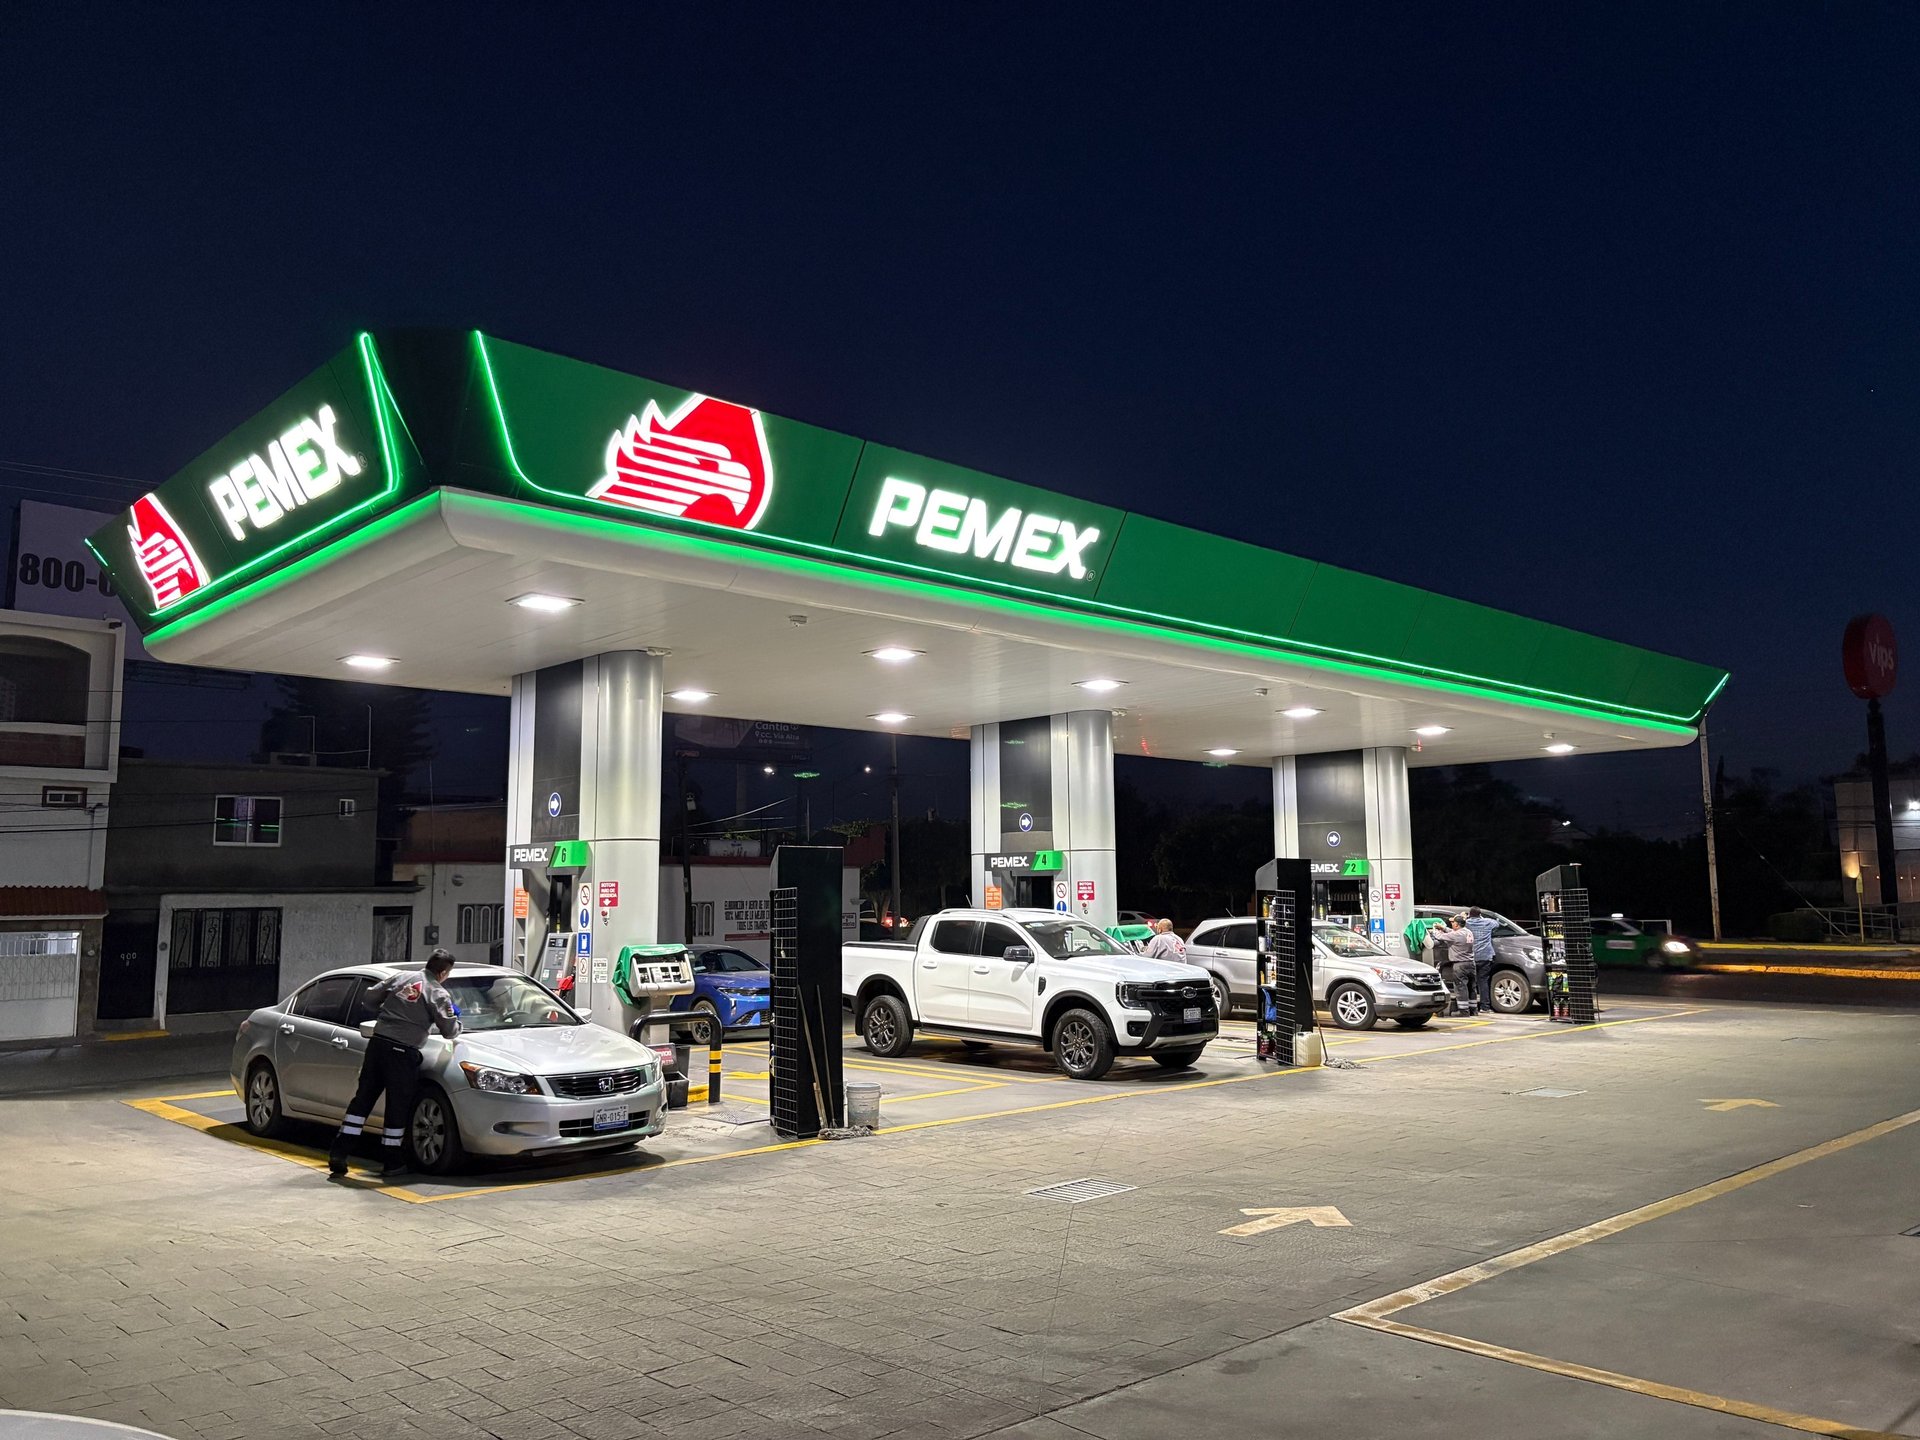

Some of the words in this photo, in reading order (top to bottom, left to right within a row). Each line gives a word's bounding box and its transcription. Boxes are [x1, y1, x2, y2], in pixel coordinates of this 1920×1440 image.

[208, 403, 361, 541] PEMEX
[867, 475, 1101, 580] PEMEX
[513, 847, 548, 863] PEMEX
[561, 847, 568, 863] 6
[990, 855, 1029, 868] PEMEX
[1041, 853, 1048, 866] 4
[1310, 863, 1339, 873] EMEX
[1350, 863, 1356, 873] 2
